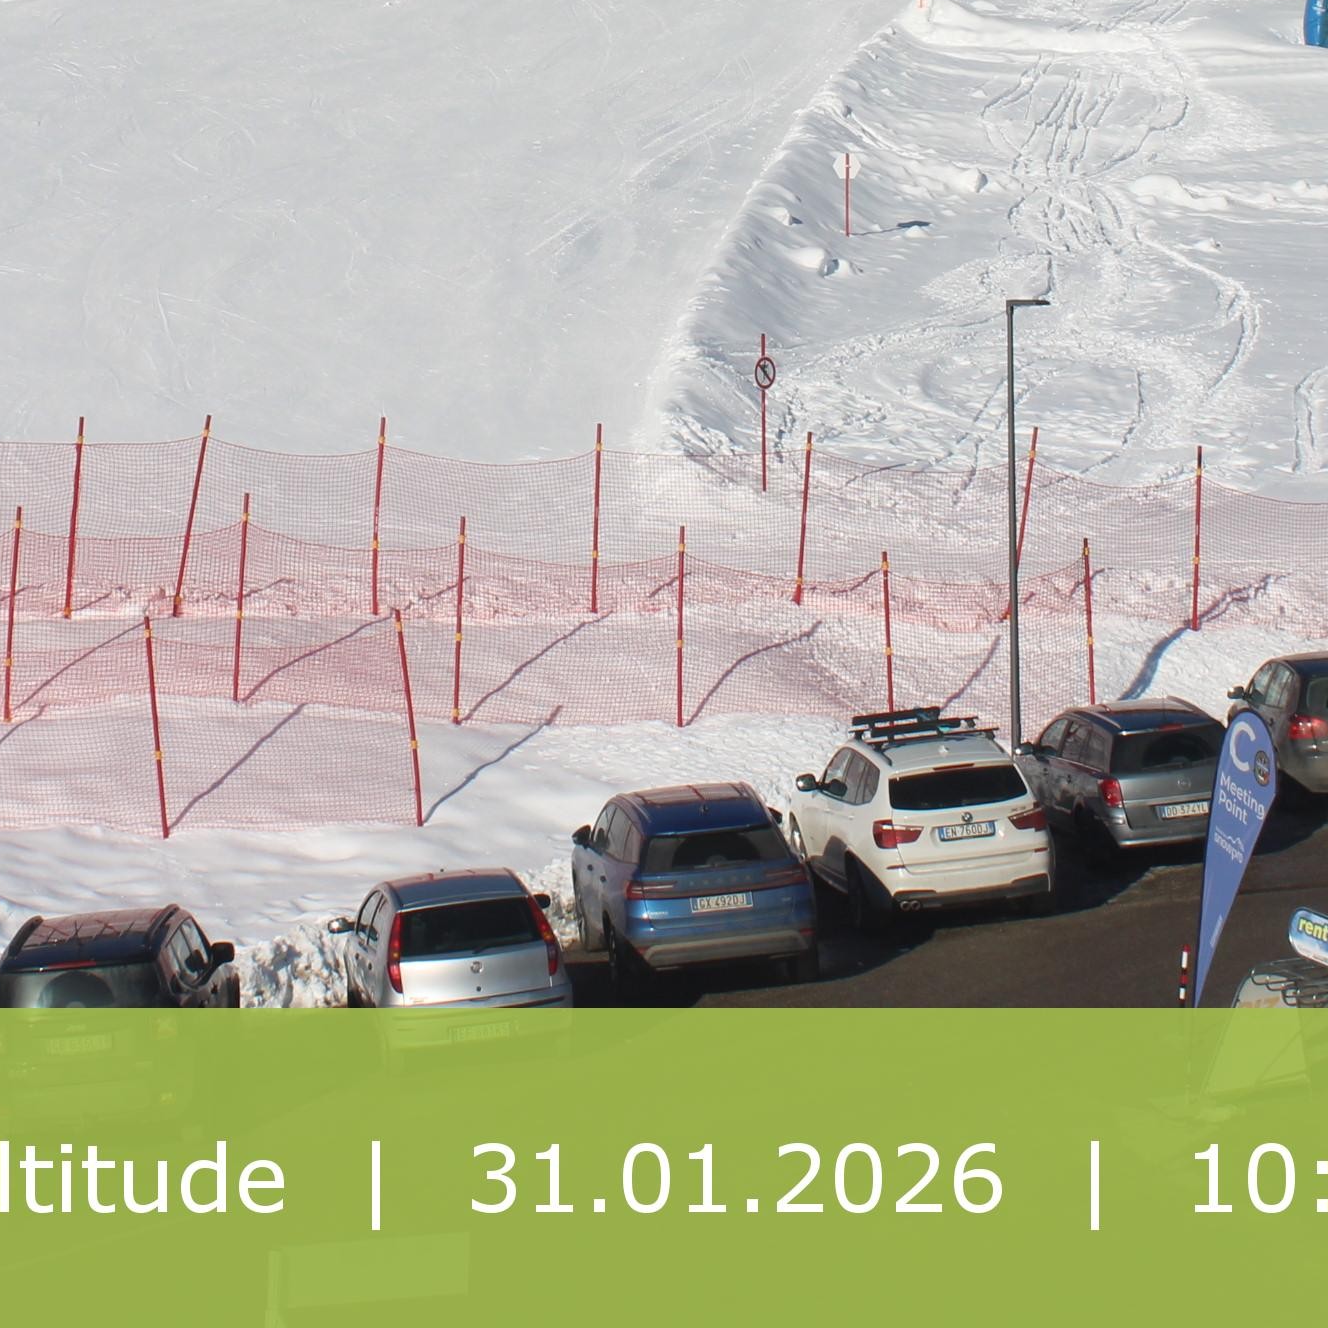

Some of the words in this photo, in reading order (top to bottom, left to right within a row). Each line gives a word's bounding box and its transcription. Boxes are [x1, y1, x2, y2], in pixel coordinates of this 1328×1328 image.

[1218, 789, 1249, 825] Point
[1219, 772, 1266, 821] Meeting
[1213, 831, 1244, 864] snowpro
